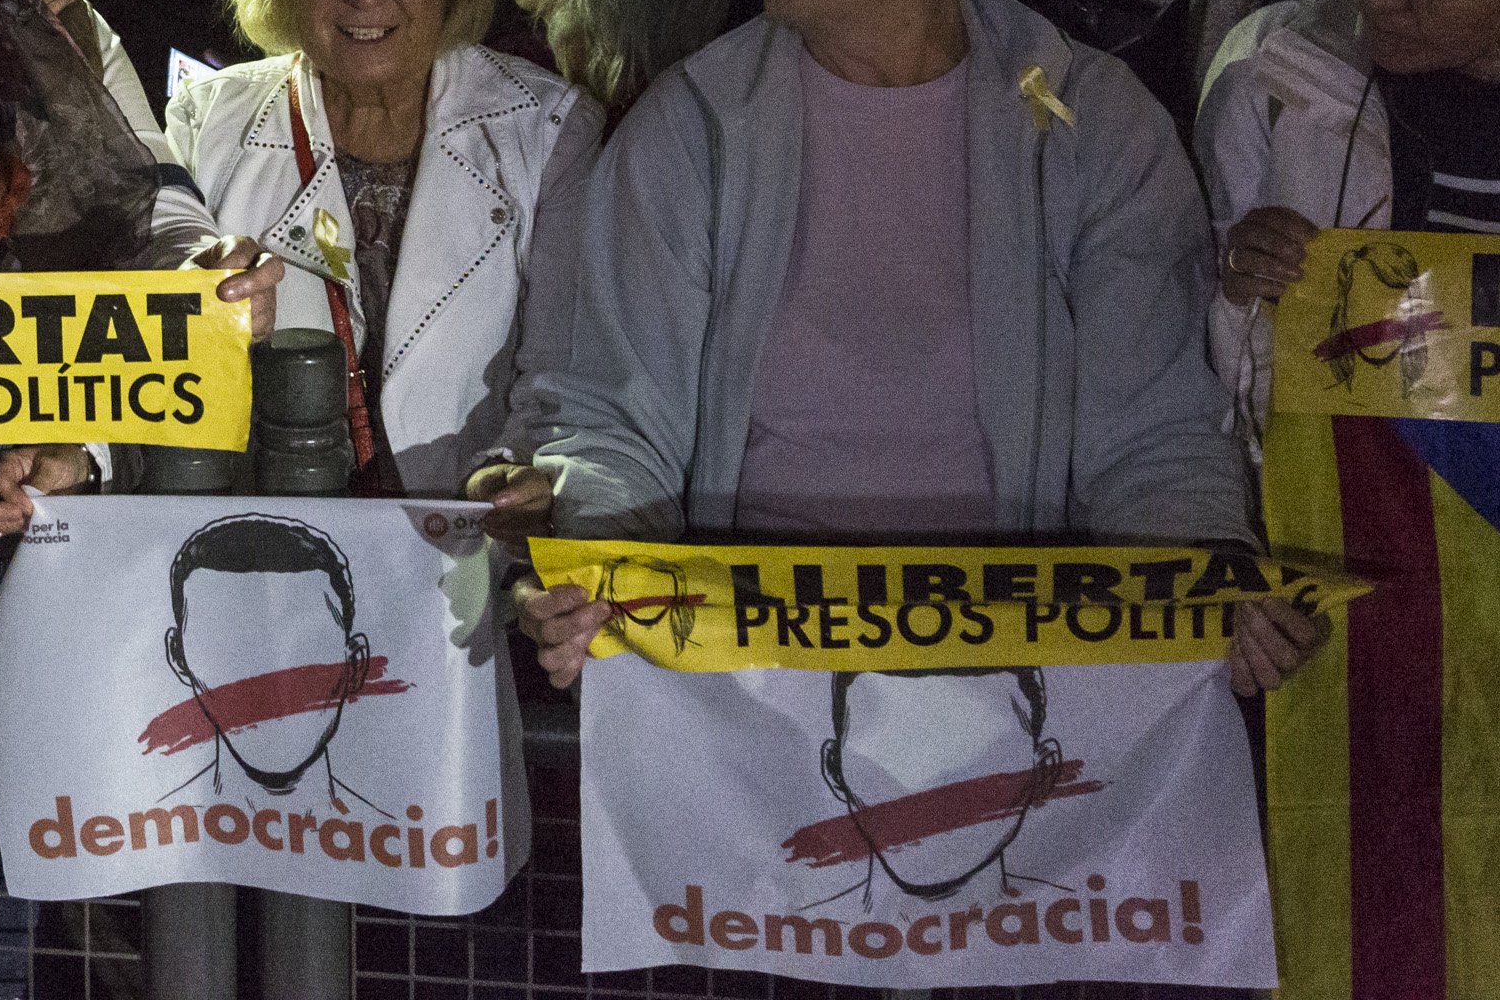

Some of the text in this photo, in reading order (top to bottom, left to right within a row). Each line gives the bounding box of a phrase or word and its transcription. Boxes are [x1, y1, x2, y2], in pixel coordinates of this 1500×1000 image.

[23, 531, 70, 544] ocràcia
[31, 519, 70, 535] per la
[731, 551, 1306, 604] LLIBERTA
[735, 599, 995, 649] PRESOS
[28, 795, 498, 869] democràcia!
[652, 873, 1206, 959] democràcia!
